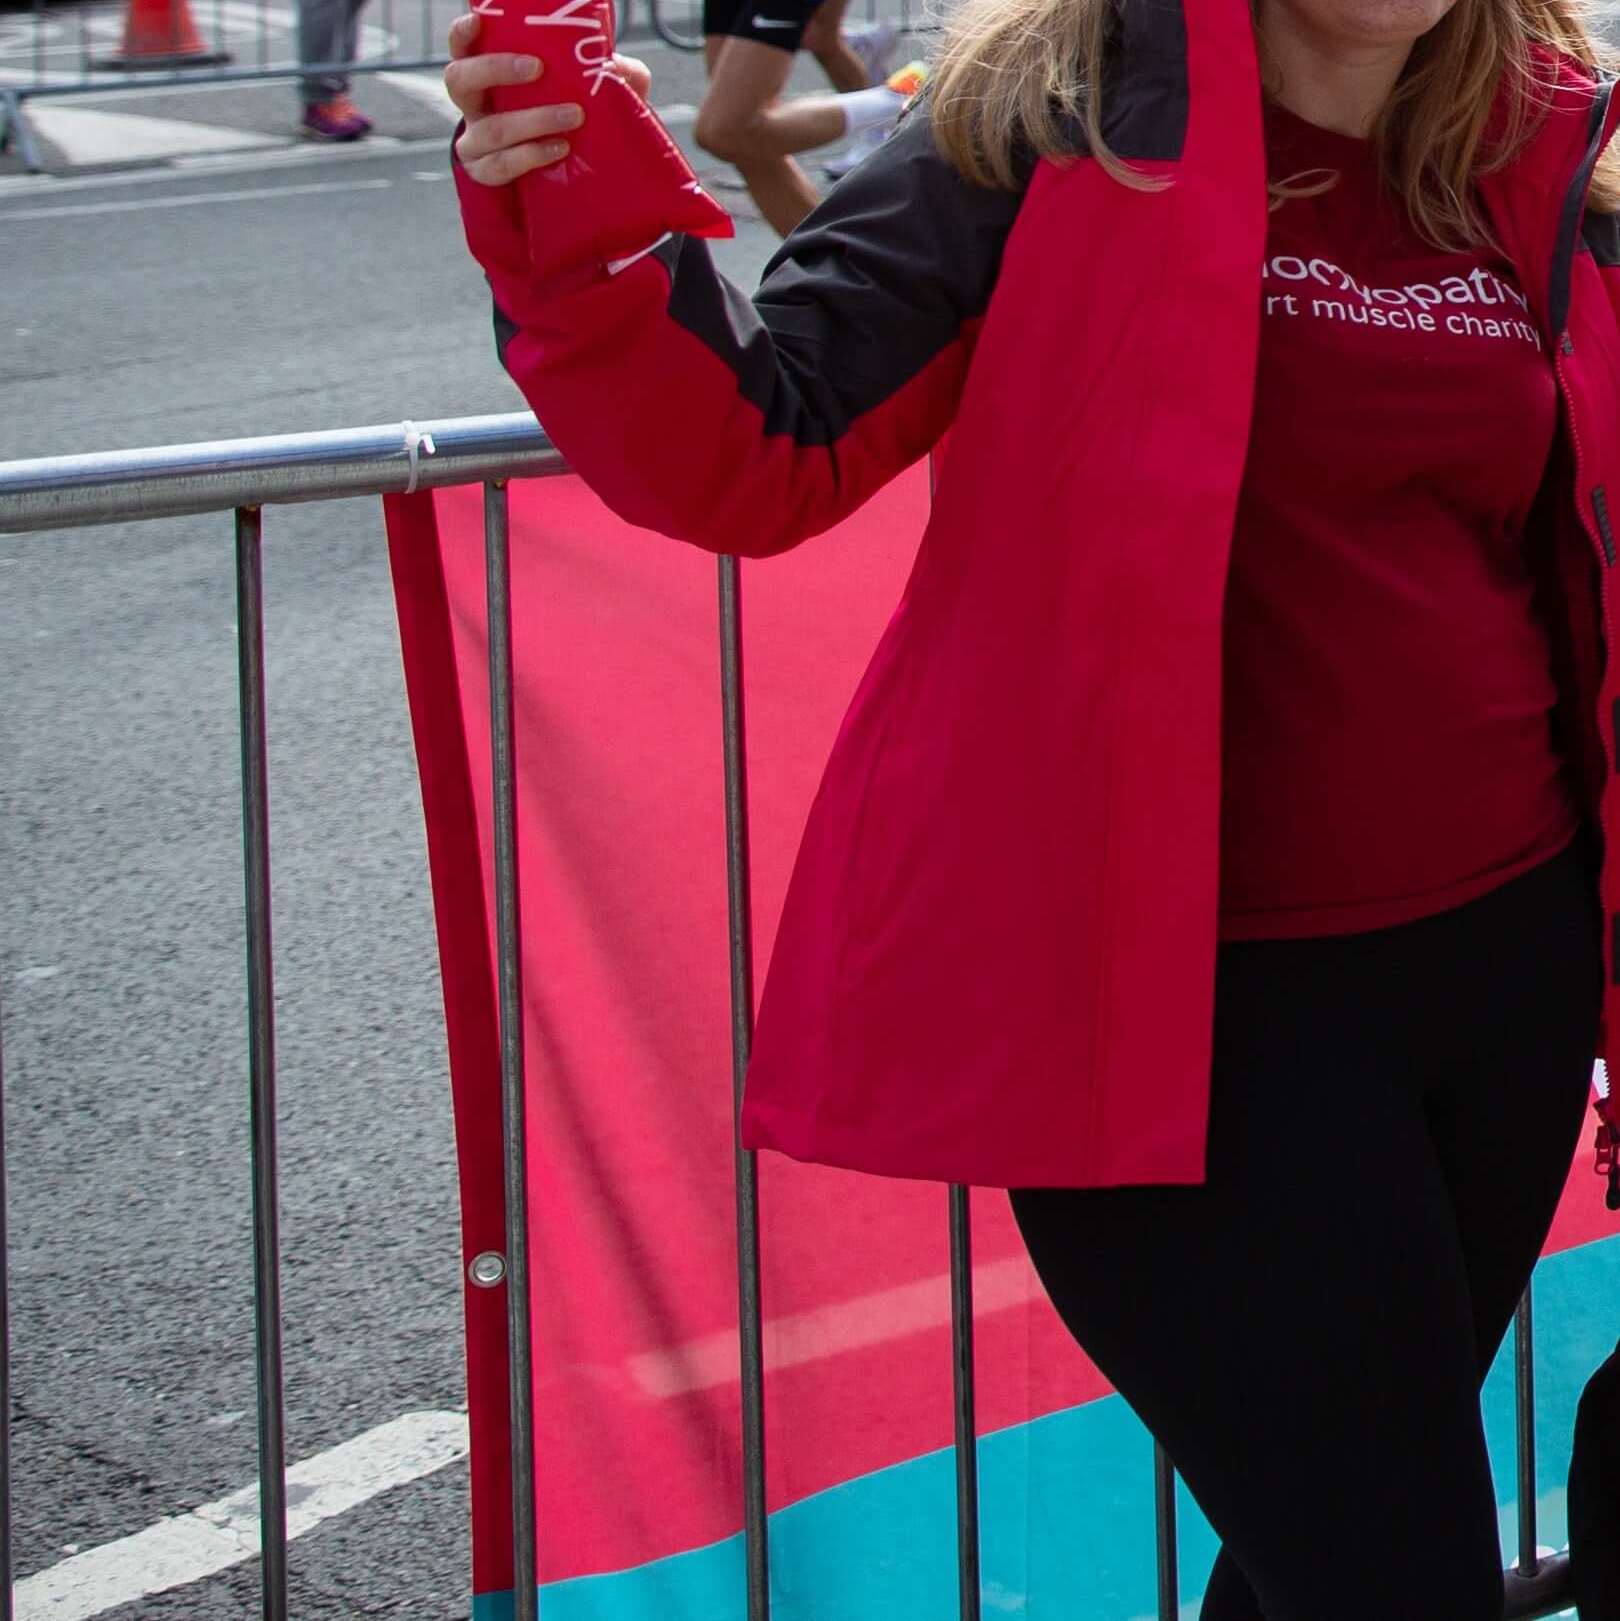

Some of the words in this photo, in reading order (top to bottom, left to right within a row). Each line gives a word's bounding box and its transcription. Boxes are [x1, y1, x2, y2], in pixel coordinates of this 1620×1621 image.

[574, 35, 627, 98] UK
[1311, 298, 1437, 332] muscle
[1446, 311, 1541, 353] charity
